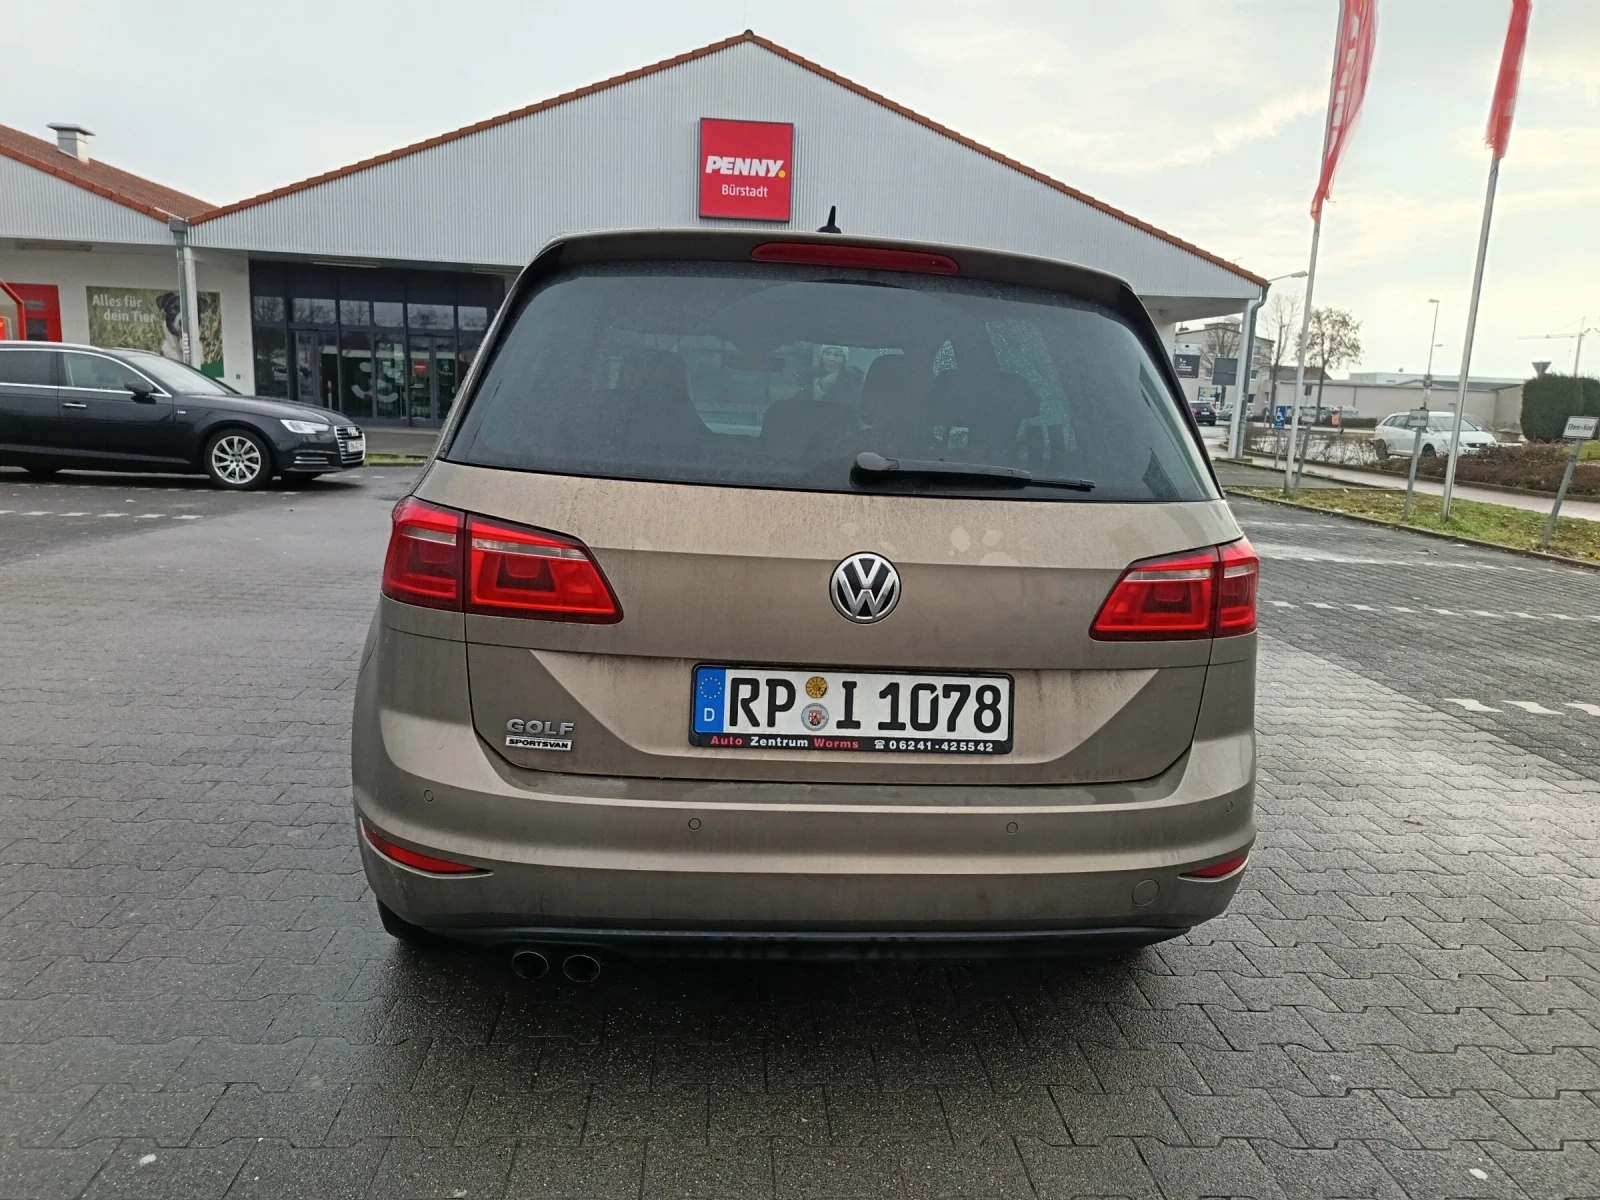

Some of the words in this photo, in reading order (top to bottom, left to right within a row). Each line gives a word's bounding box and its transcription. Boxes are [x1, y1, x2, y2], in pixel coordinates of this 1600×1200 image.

[721, 184, 768, 198] Bürstadt
[92, 294, 121, 307] Alles
[123, 295, 142, 308] für
[103, 308, 129, 321] dein
[131, 311, 155, 322] Tier
[703, 707, 715, 722] D
[728, 677, 797, 728] RP
[835, 680, 862, 730] I
[877, 681, 1002, 734] 1078
[506, 718, 575, 736] GOLF
[508, 738, 569, 749] SPORTSVAN
[710, 735, 743, 746] Auto
[750, 736, 809, 748] Zentrum
[813, 738, 860, 749] Worms
